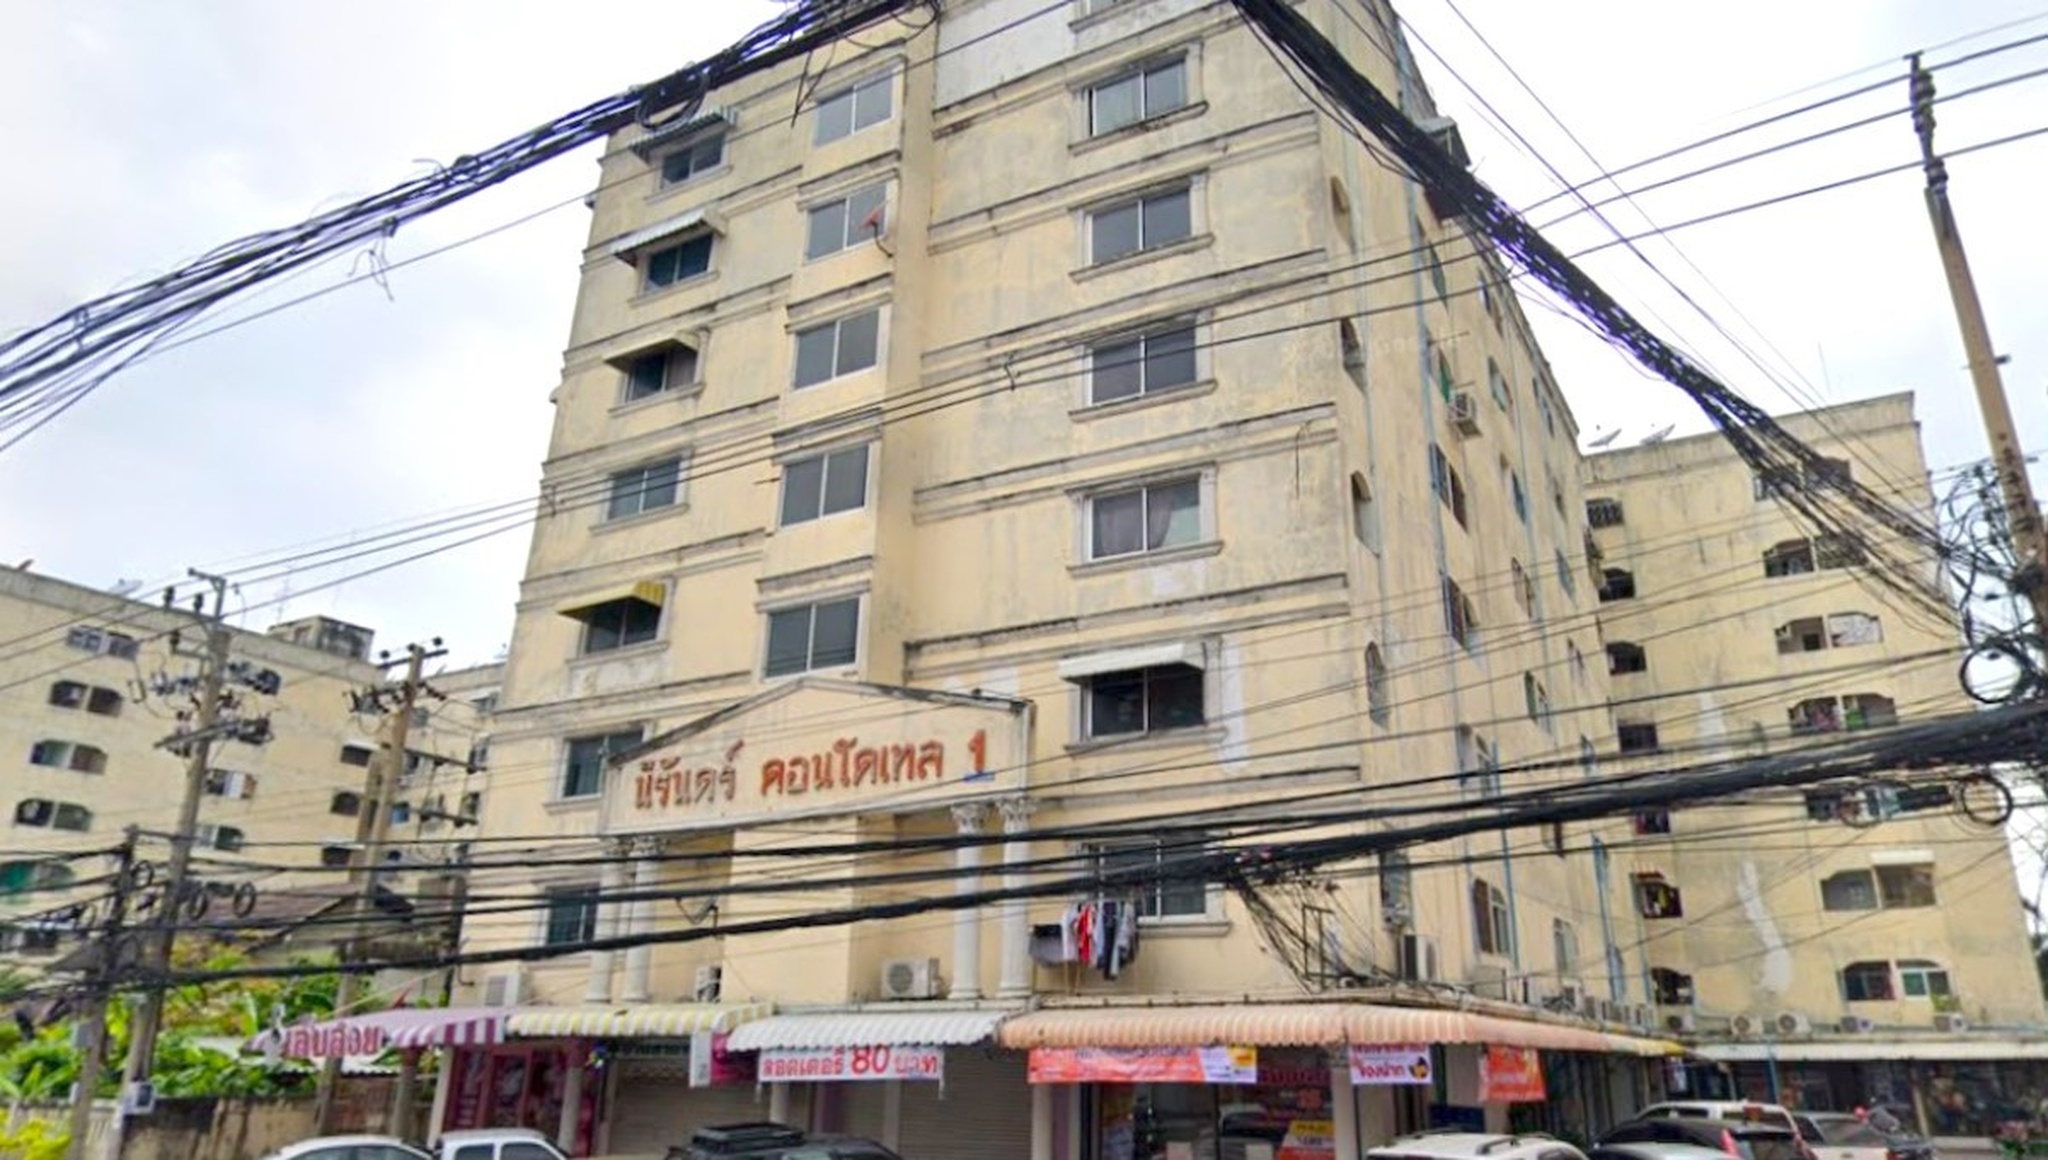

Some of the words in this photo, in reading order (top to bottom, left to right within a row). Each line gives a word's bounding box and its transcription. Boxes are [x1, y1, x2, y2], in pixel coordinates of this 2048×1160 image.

[760, 736, 943, 797] คอนโดเทล
[965, 729, 994, 782] 1
[851, 1044, 890, 1074] 80
[894, 1053, 938, 1075] บาท
